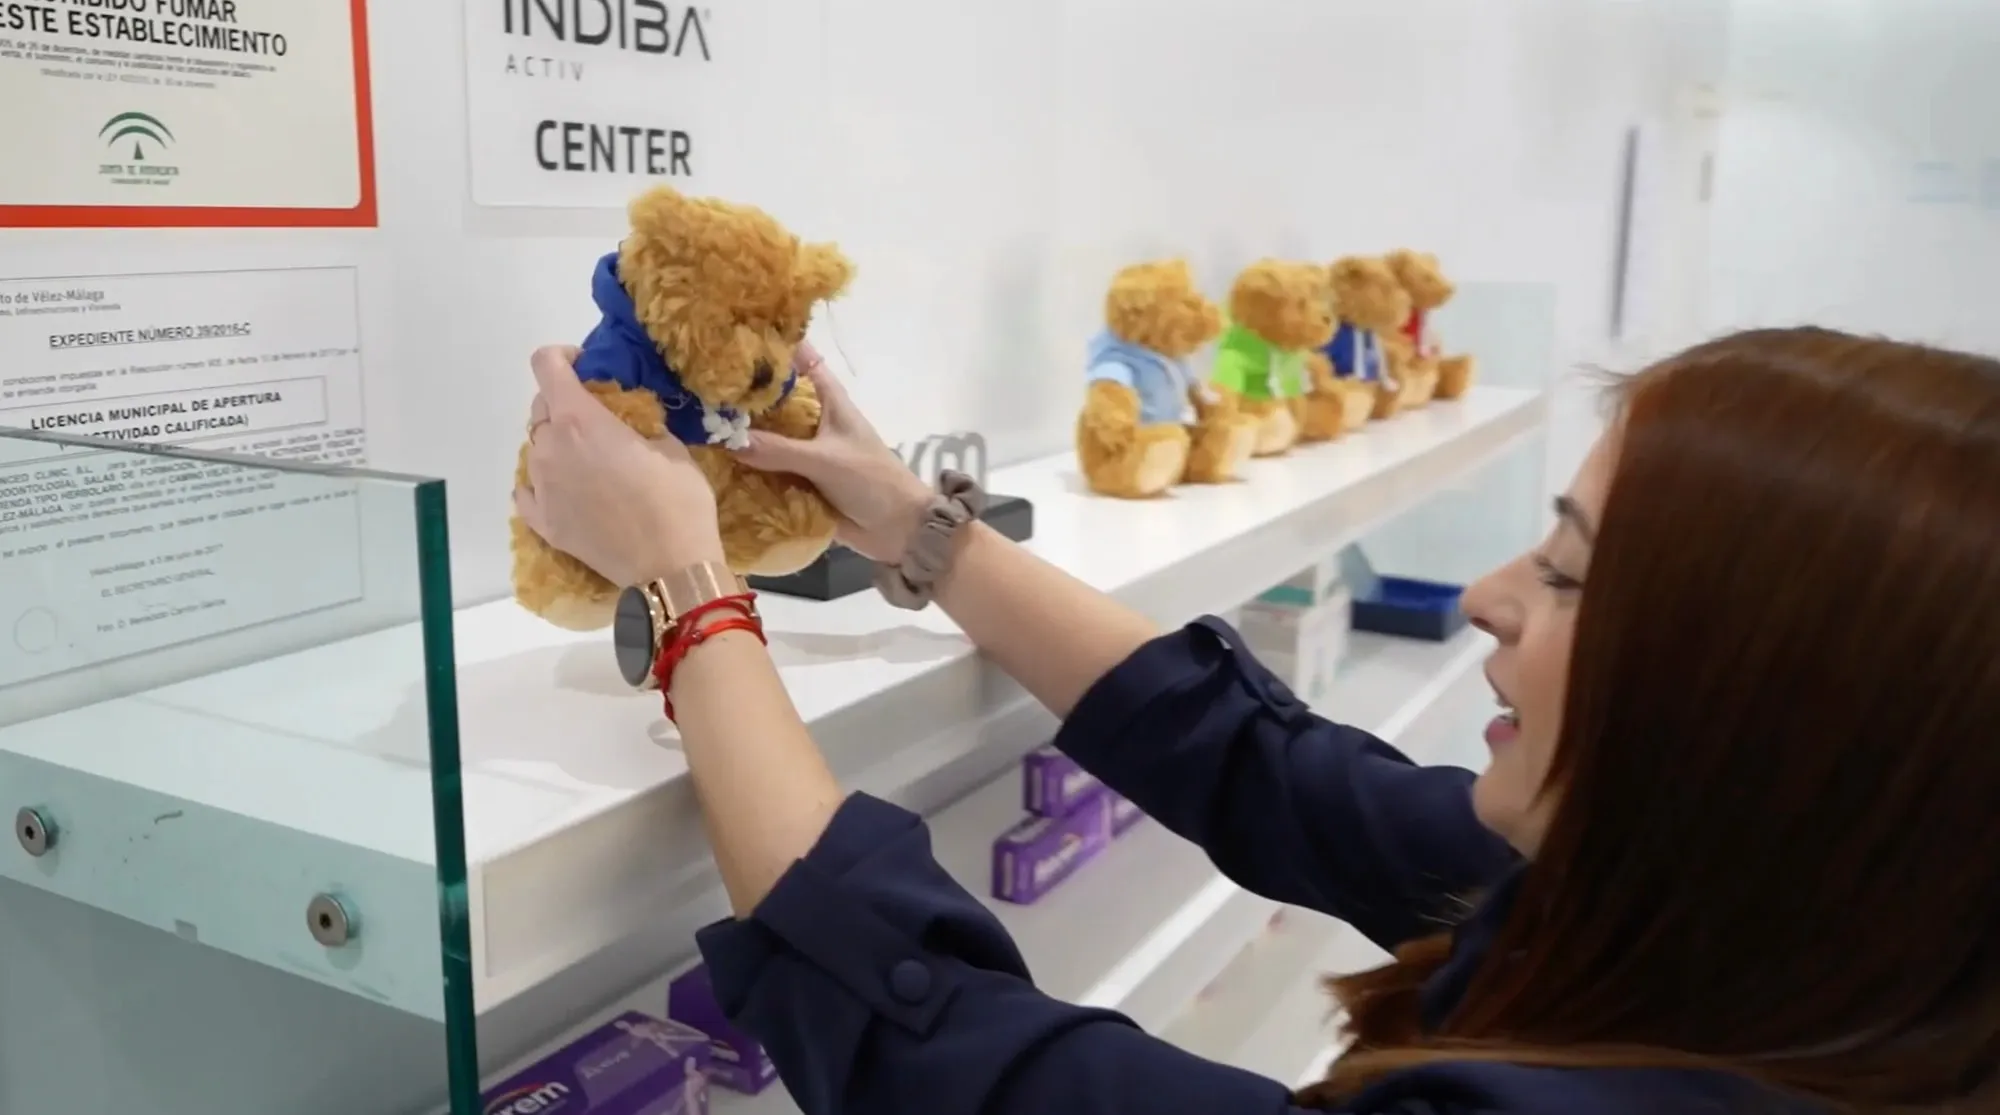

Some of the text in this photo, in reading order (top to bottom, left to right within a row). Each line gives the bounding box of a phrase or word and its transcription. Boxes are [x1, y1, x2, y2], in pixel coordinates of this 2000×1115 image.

[156, 0, 238, 23] FUMAR
[68, 10, 287, 56] ESTABLECIMIENTO
[505, 54, 584, 81] ACTIV
[535, 119, 692, 177] CENTER
[49, 329, 134, 348] EXPEDIENTE
[31, 391, 282, 431] LICENCIA MUNICIPAL DE APERTURA
